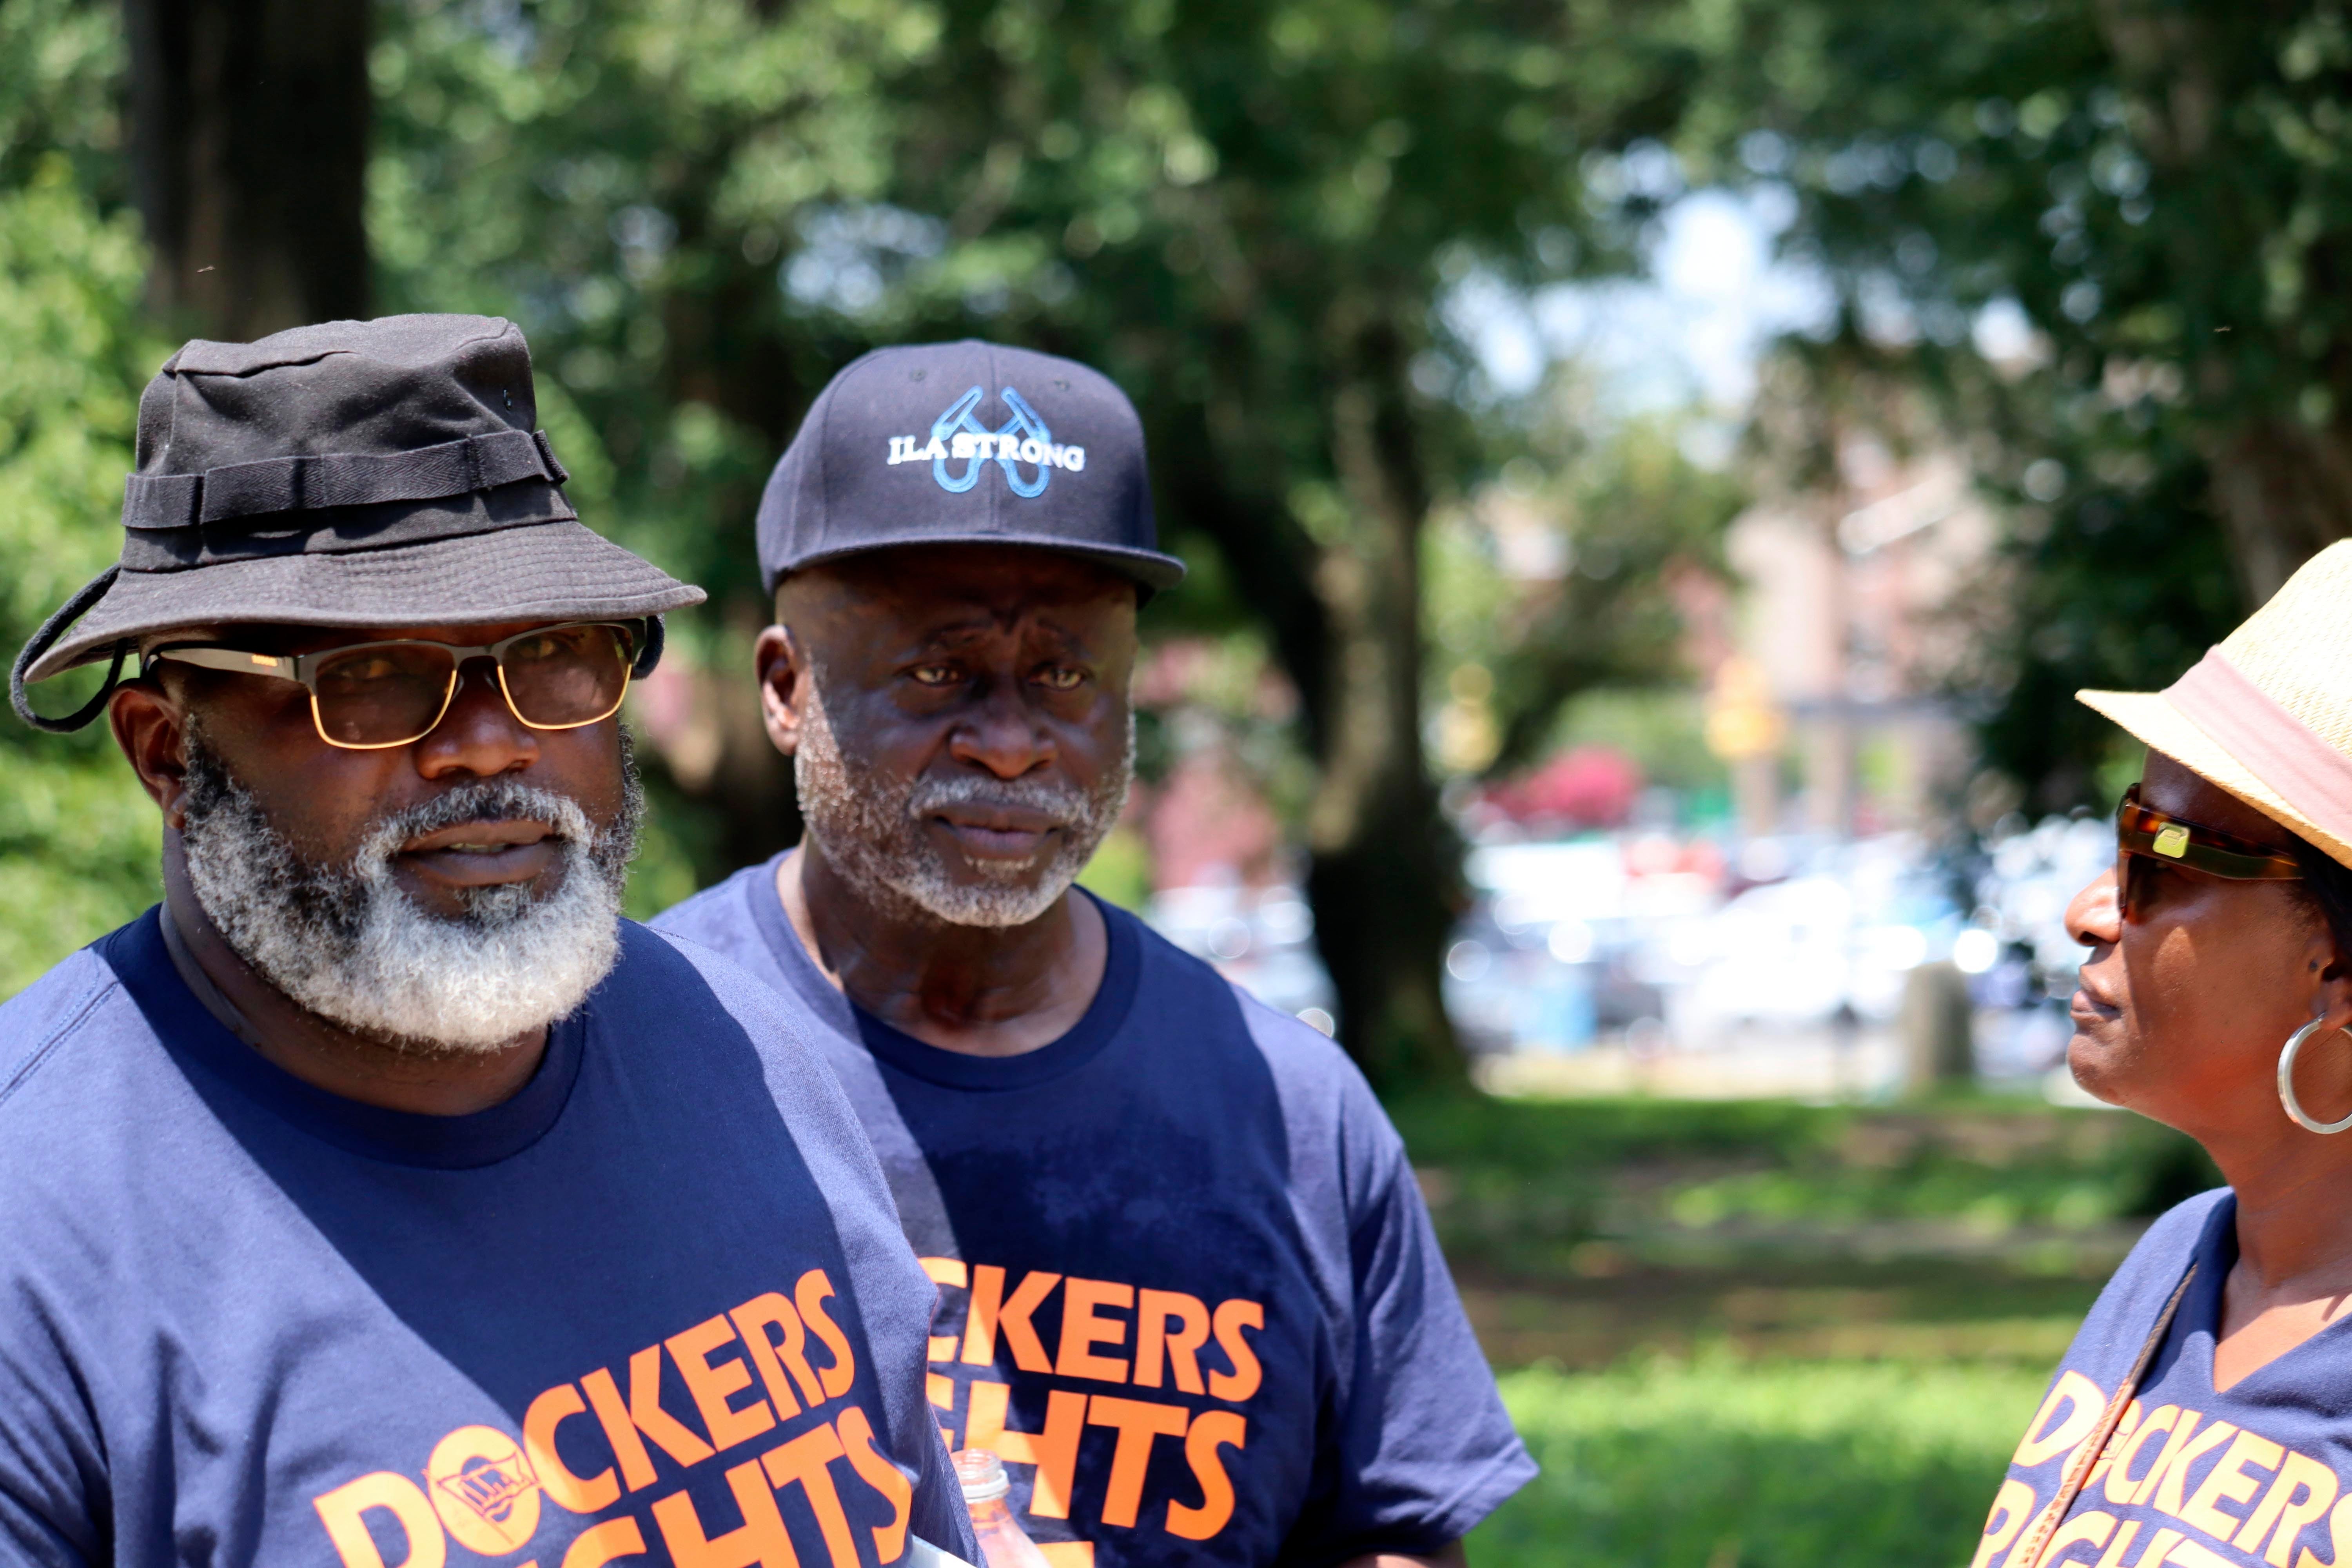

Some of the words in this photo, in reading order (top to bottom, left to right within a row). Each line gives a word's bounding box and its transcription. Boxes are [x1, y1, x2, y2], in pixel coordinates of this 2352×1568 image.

[887, 435, 949, 465] ILA
[951, 432, 1085, 471] STRONG
[313, 1269, 855, 1568] DOCKERS
[515, 1406, 912, 1568] HTS
